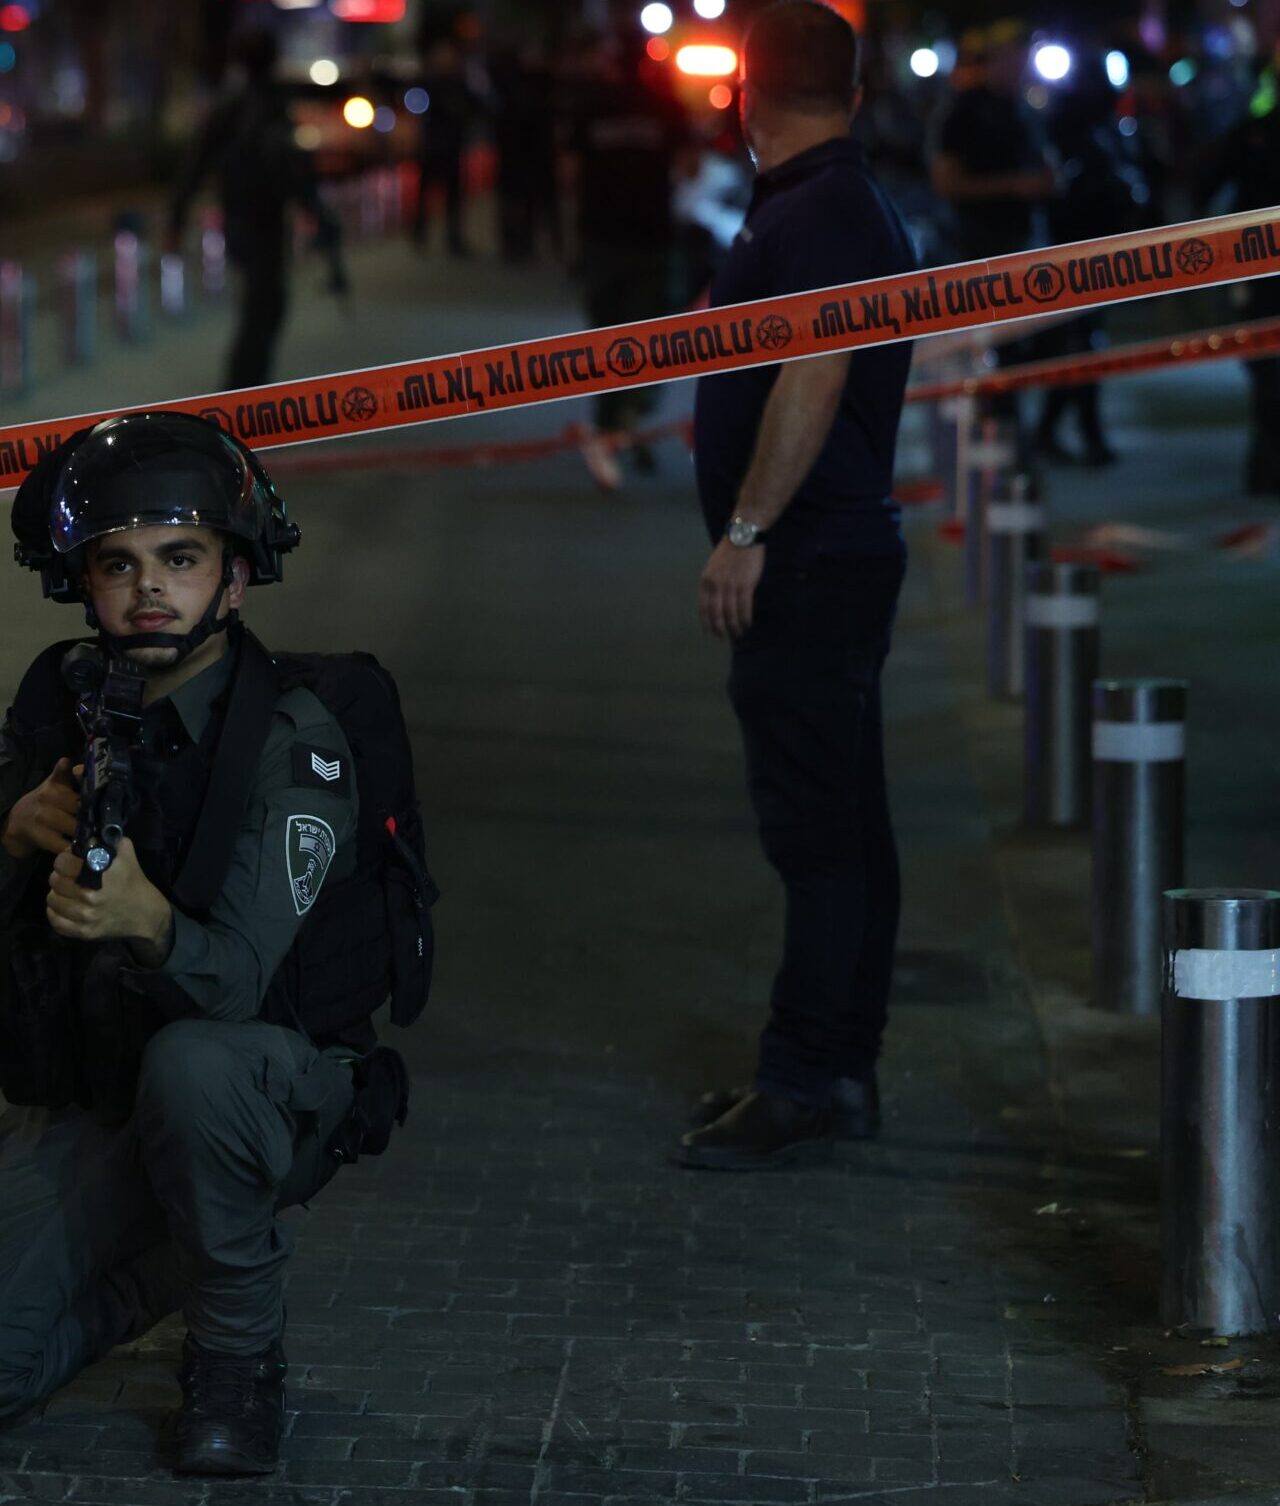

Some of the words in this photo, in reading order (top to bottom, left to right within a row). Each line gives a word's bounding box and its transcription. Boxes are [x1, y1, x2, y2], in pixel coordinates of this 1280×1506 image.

[236, 392, 337, 439] משטרת
[397, 368, 485, 411] ישראל
[485, 352, 524, 396] אין
[528, 347, 605, 389] מעבר
[650, 320, 753, 368] משטרת
[813, 294, 900, 336] ישראל
[902, 278, 940, 322] אין
[945, 272, 1022, 316] מעבר
[1070, 243, 1172, 293] משטרת
